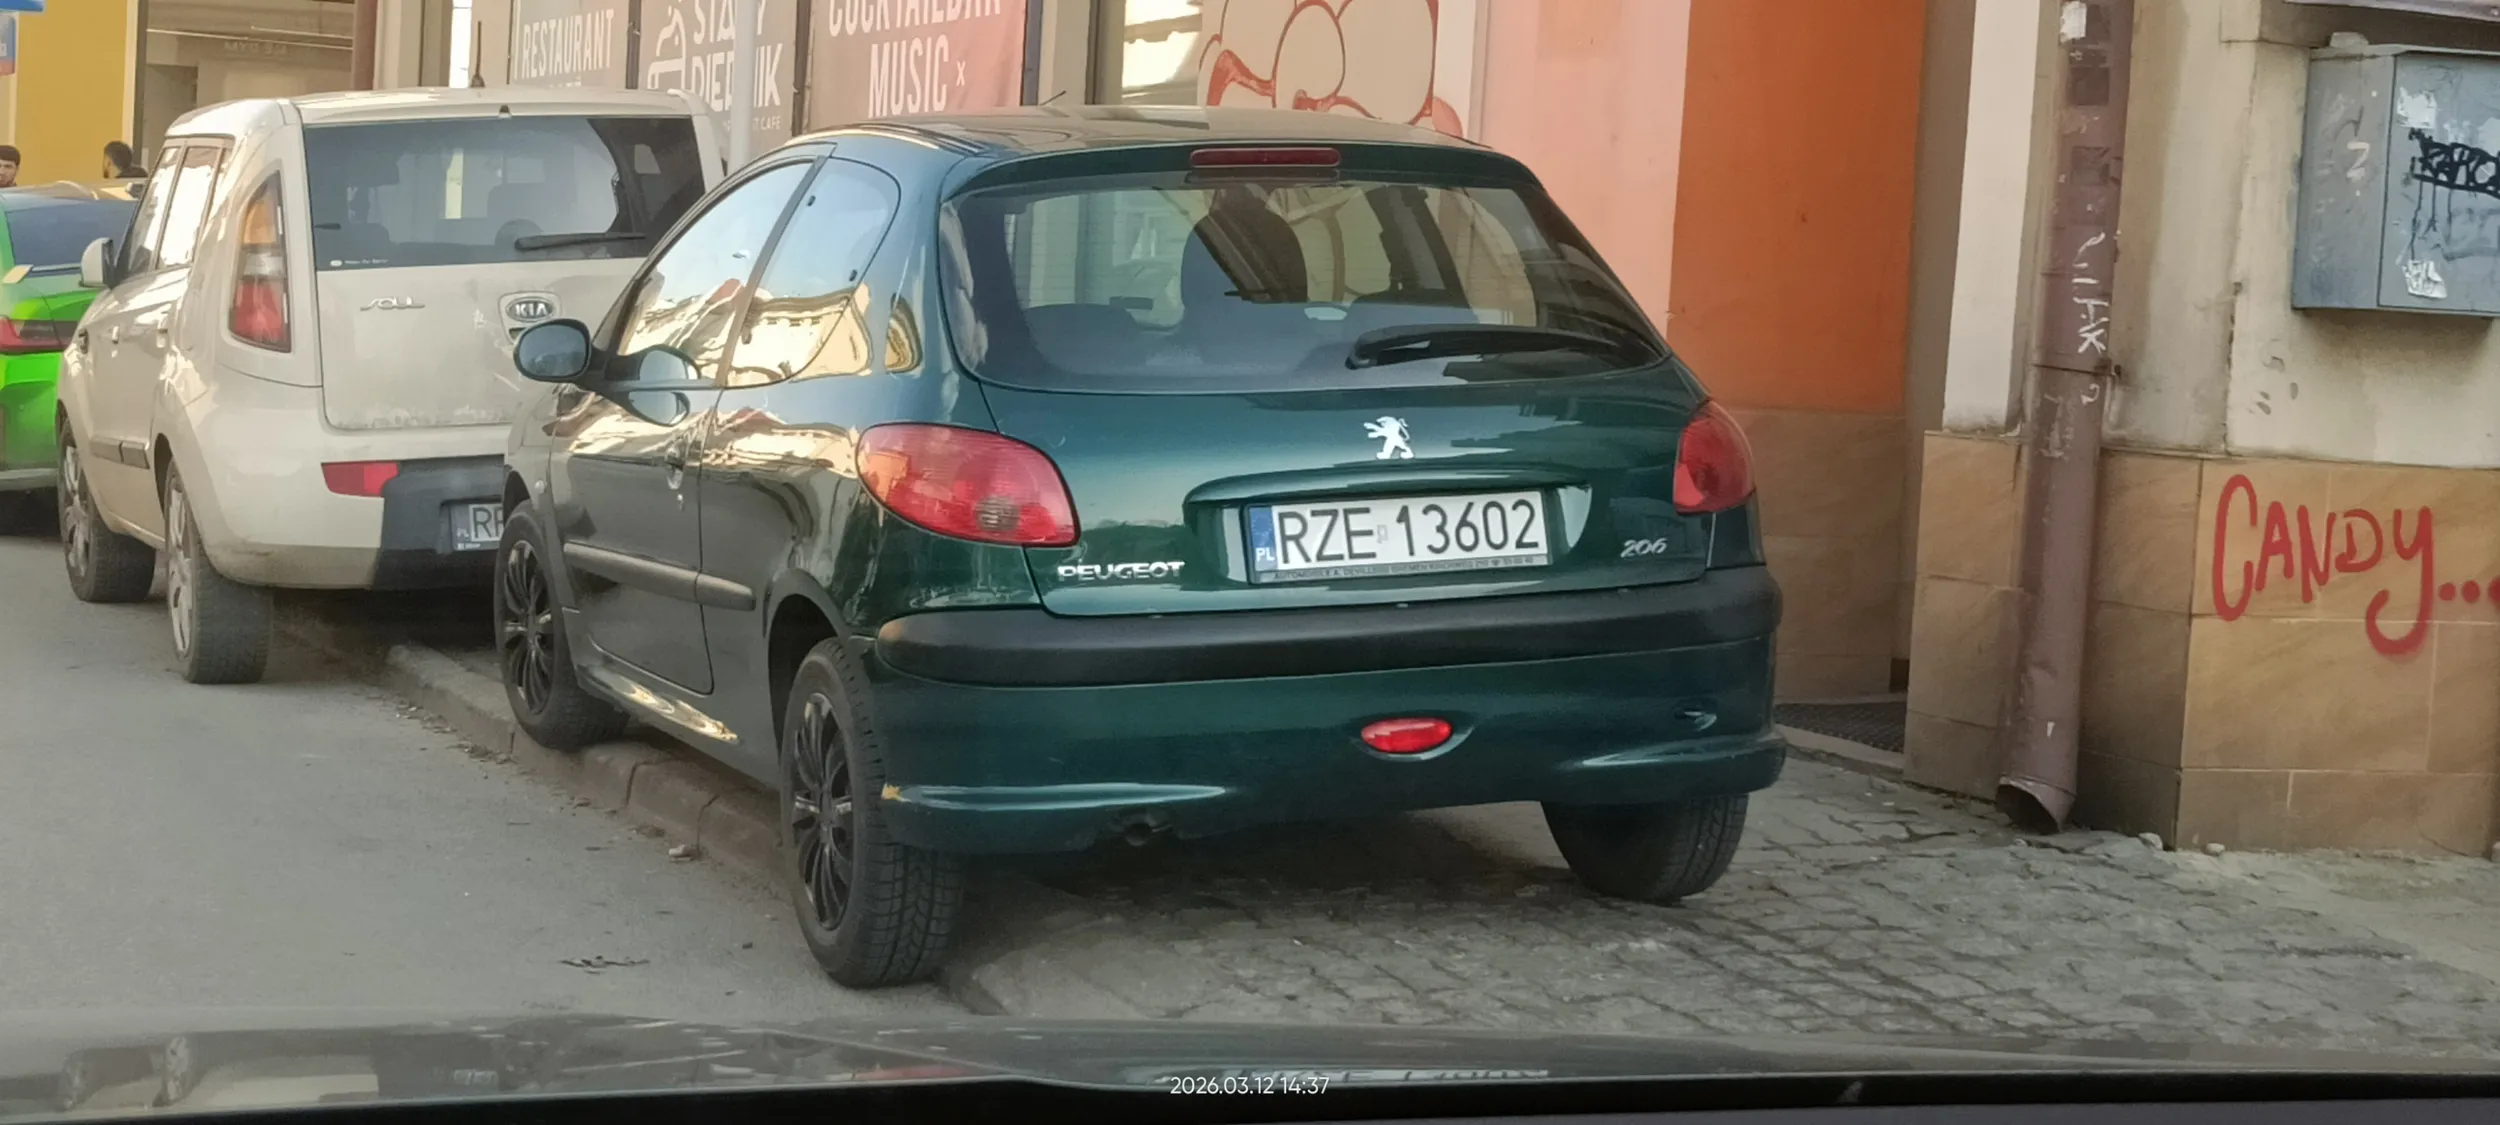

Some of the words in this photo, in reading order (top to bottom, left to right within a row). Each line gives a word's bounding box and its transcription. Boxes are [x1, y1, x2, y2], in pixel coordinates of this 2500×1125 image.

[521, 8, 614, 79] RESTAURANT
[867, 34, 949, 119] MUSIC
[515, 302, 549, 317] KIA
[1278, 506, 1377, 564] RZE
[1396, 498, 1540, 557] 13602
[1255, 547, 1275, 562] PL
[1620, 537, 1668, 558] 206
[1057, 560, 1186, 582] PEUGEOT
